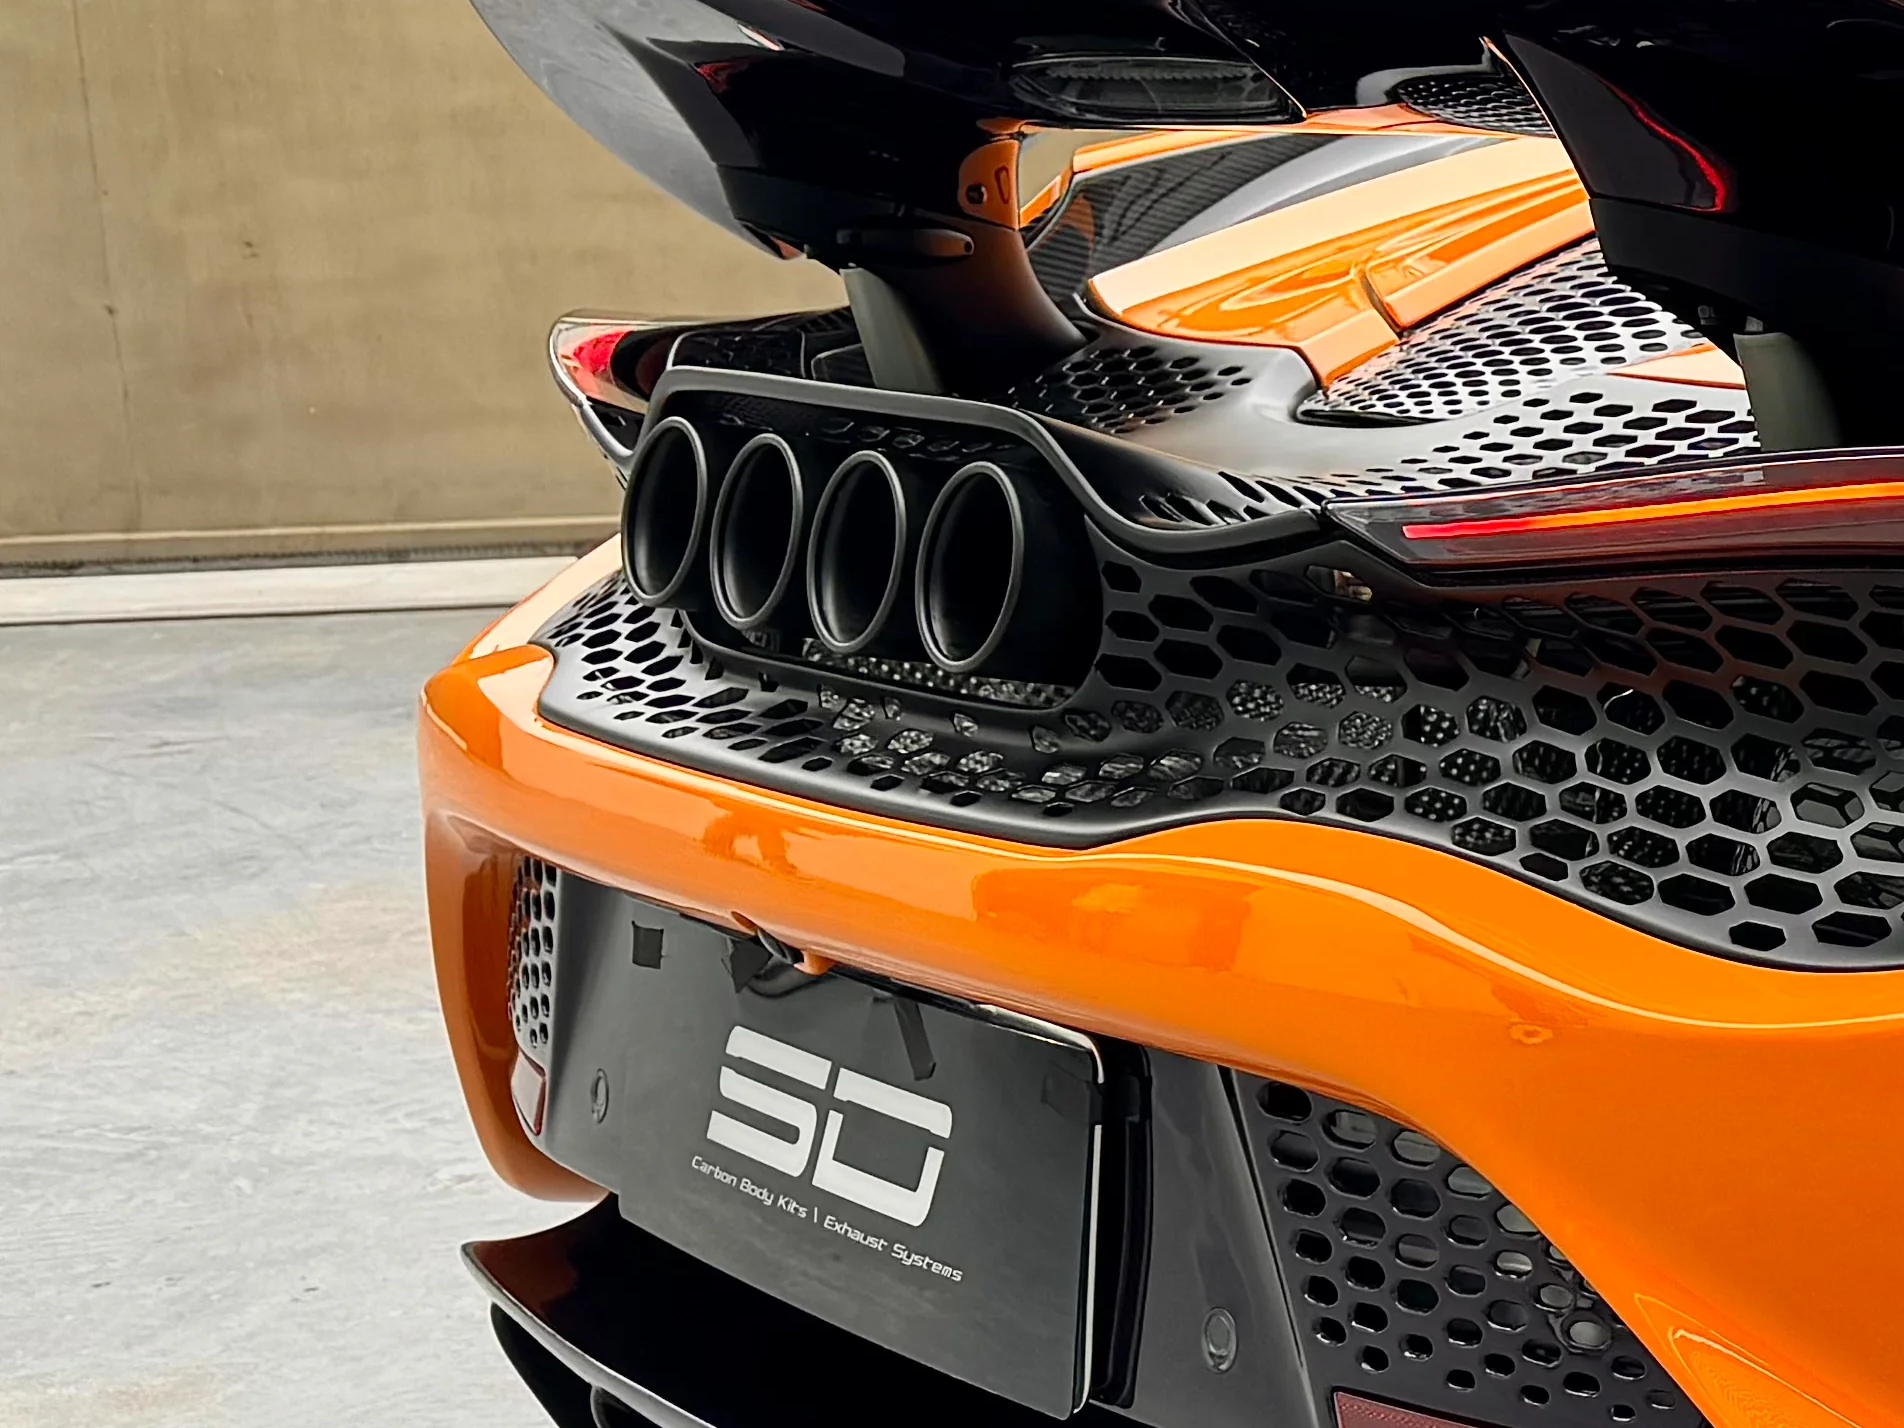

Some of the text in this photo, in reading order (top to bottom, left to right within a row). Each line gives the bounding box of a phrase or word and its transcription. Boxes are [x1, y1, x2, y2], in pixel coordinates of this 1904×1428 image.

[706, 1025, 953, 1228] SD
[691, 1154, 738, 1188] Carbon
[738, 1177, 775, 1206] Body
[776, 1194, 808, 1219] Kits
[823, 1214, 889, 1252] Exhaust
[890, 1242, 964, 1283] Systems
